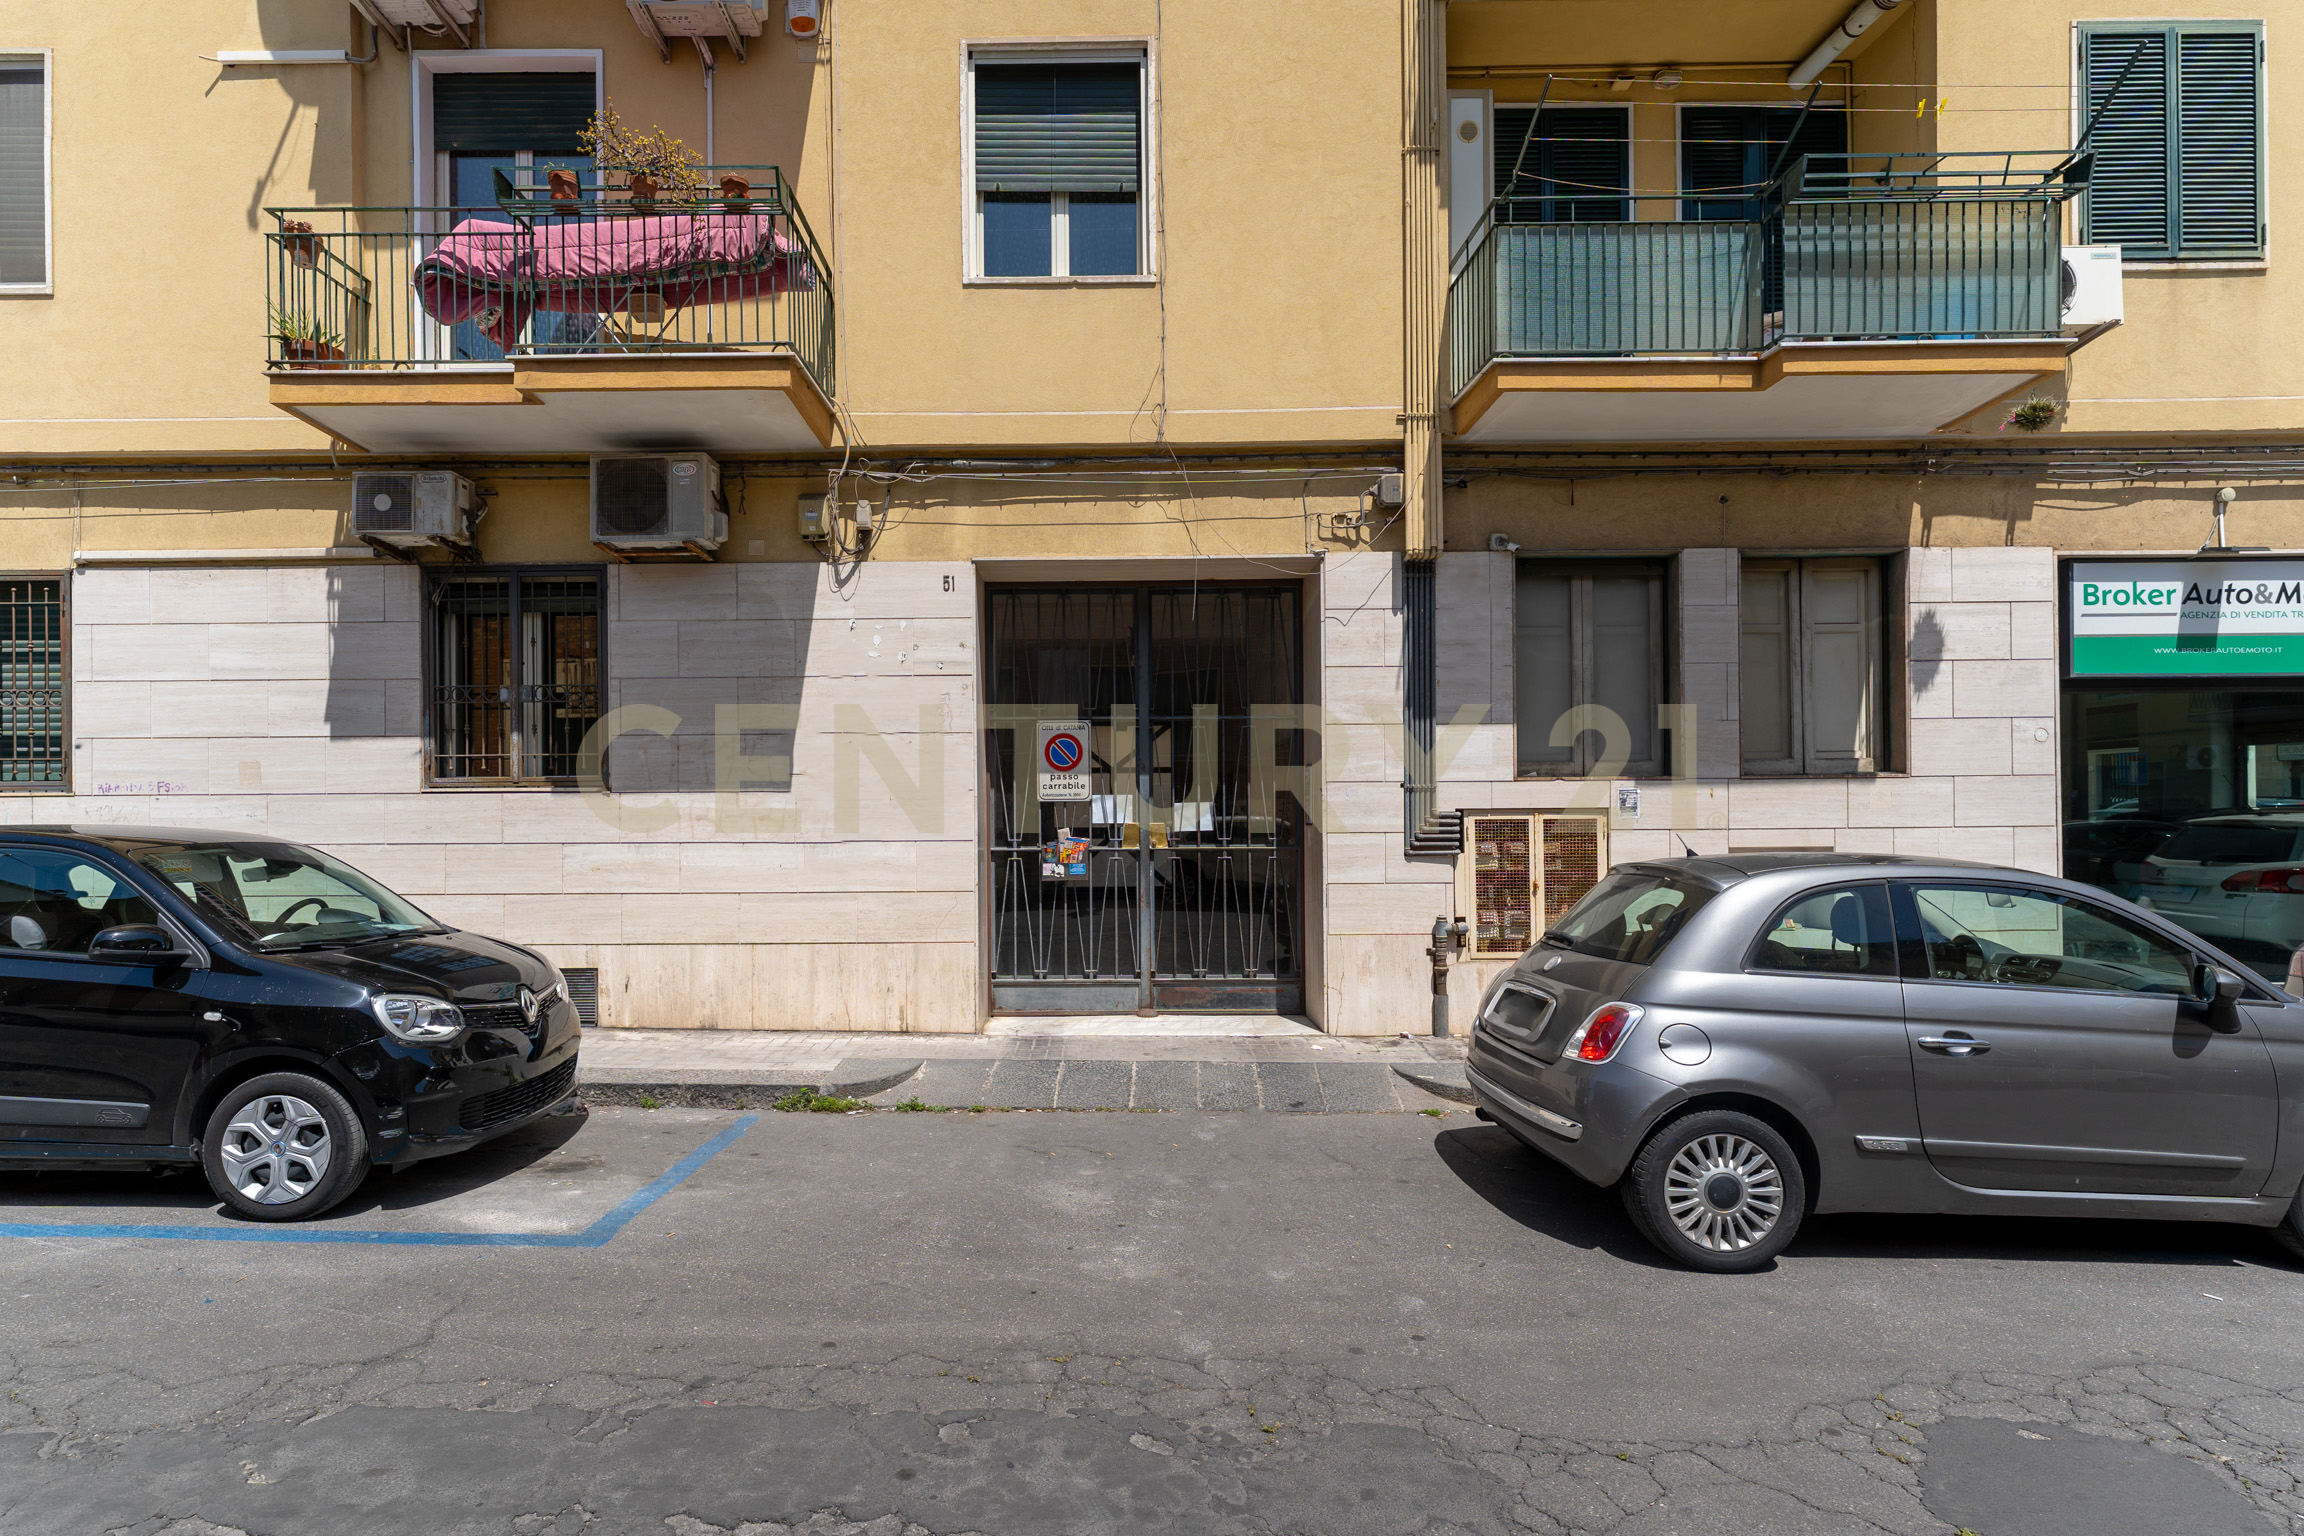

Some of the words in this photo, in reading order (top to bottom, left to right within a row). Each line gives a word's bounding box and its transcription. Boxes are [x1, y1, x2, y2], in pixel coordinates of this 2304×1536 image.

[943, 575, 955, 592] 51
[2083, 581, 2177, 606] Broker
[2181, 581, 2304, 605] Auto&M
[2180, 610, 2228, 619] AGENZIA
[2230, 610, 2241, 619] DI
[2243, 610, 2288, 619] VENDITA
[1050, 774, 1079, 782] passo
[1042, 782, 1086, 790] carrabile
